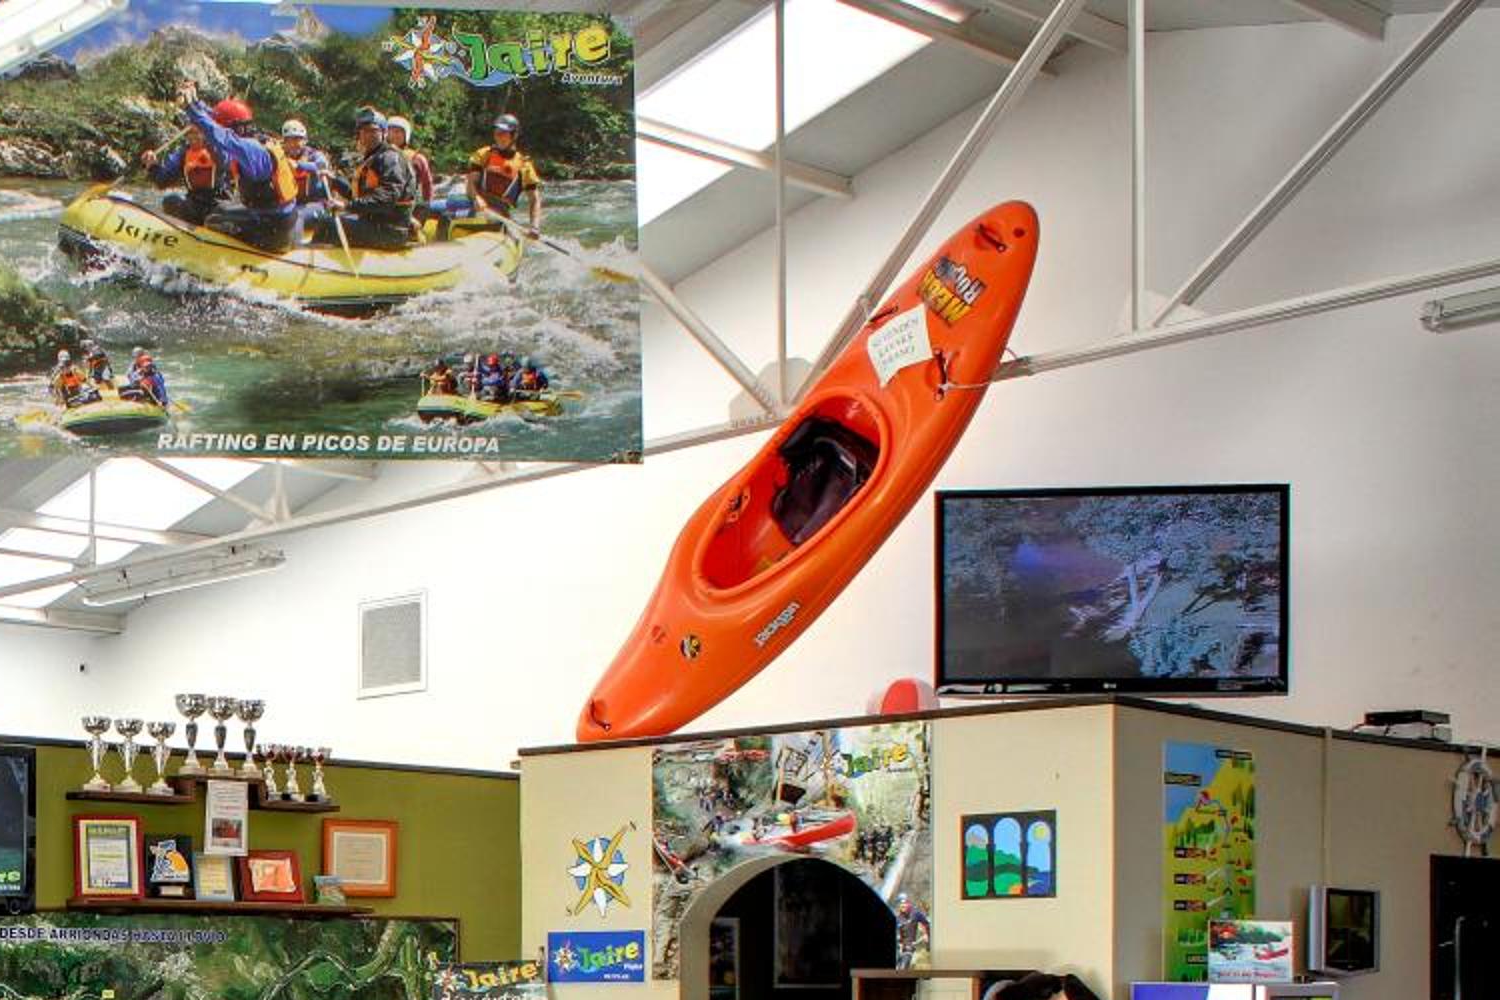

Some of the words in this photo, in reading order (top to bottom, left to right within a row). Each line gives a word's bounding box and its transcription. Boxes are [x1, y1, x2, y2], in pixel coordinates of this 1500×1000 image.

[452, 26, 612, 80] Jaire
[157, 433, 256, 451] RAFTING
[264, 434, 295, 451] EN
[302, 434, 369, 451] PICOS
[377, 436, 405, 452] DE
[412, 436, 500, 453] EUROPA
[0, 926, 45, 941] DESDE
[49, 926, 128, 942] ARRIONDAS
[578, 941, 640, 971] Jaire
[461, 963, 537, 987] Jaire
